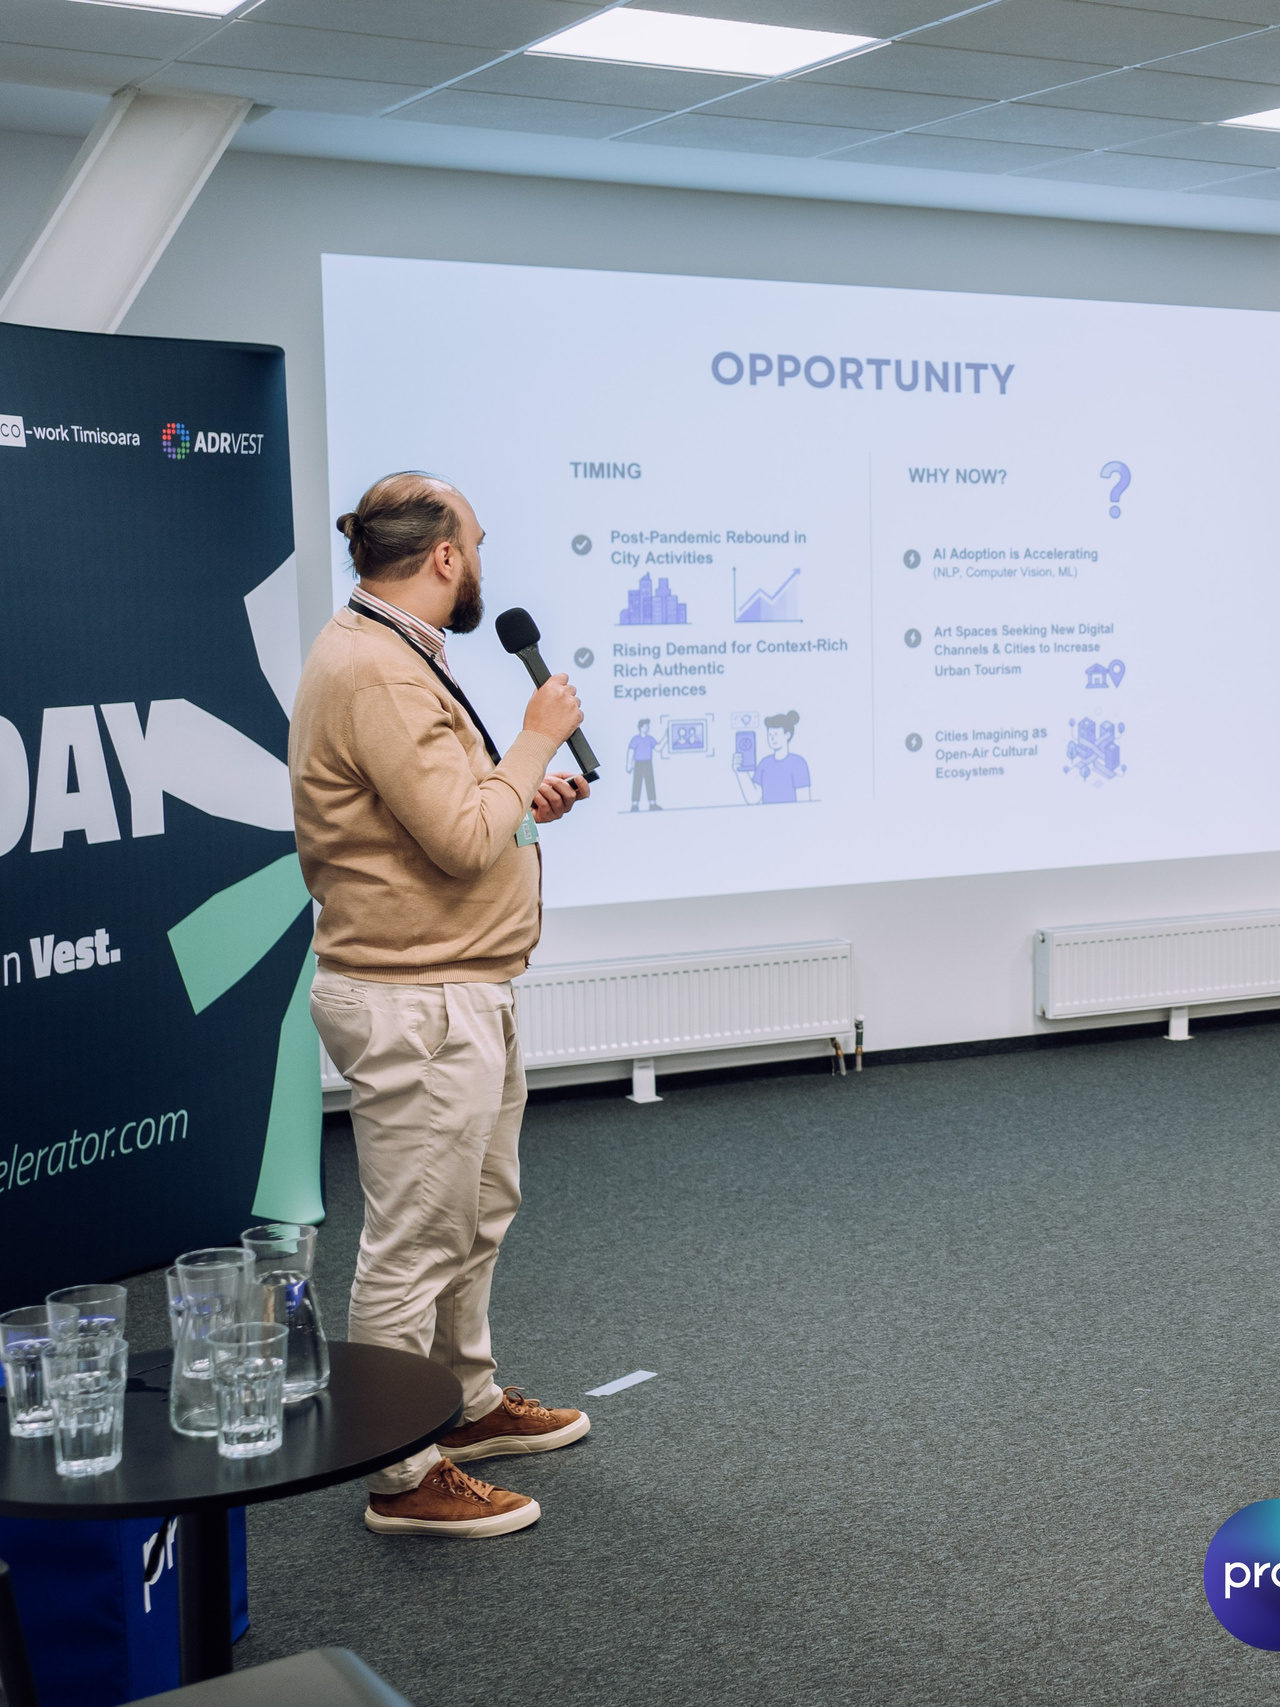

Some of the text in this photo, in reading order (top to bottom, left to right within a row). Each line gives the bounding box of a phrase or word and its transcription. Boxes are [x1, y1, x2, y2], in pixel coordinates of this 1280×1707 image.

[711, 350, 1016, 395] OPPORTUNITY
[71, 425, 140, 446] Timisoara
[194, 431, 264, 455] ADRVEST
[569, 461, 642, 480] TIMING
[908, 467, 1007, 485] WHY NOW?
[610, 530, 807, 544] Post-Pandemic Rebound in
[611, 551, 713, 567] City Activities
[933, 548, 1098, 562] AI Adoption is Accelerating
[933, 566, 1078, 580] (NLP, Computer Vision, ML)
[934, 623, 1114, 639] Art Spaces Seeking New Digital
[613, 638, 848, 659] Rising Demand for Context-Rich
[934, 641, 1100, 656] Channels & Cities to Increase
[613, 661, 725, 677] Rich Authentic
[935, 664, 1021, 676] Urban Tourism
[613, 684, 707, 700] Experiences
[935, 727, 1047, 742] Cities Imagining as
[935, 745, 1037, 762] Open-Air Cultural
[935, 765, 1004, 780] Ecosystems
[29, 928, 121, 979] Vest.
